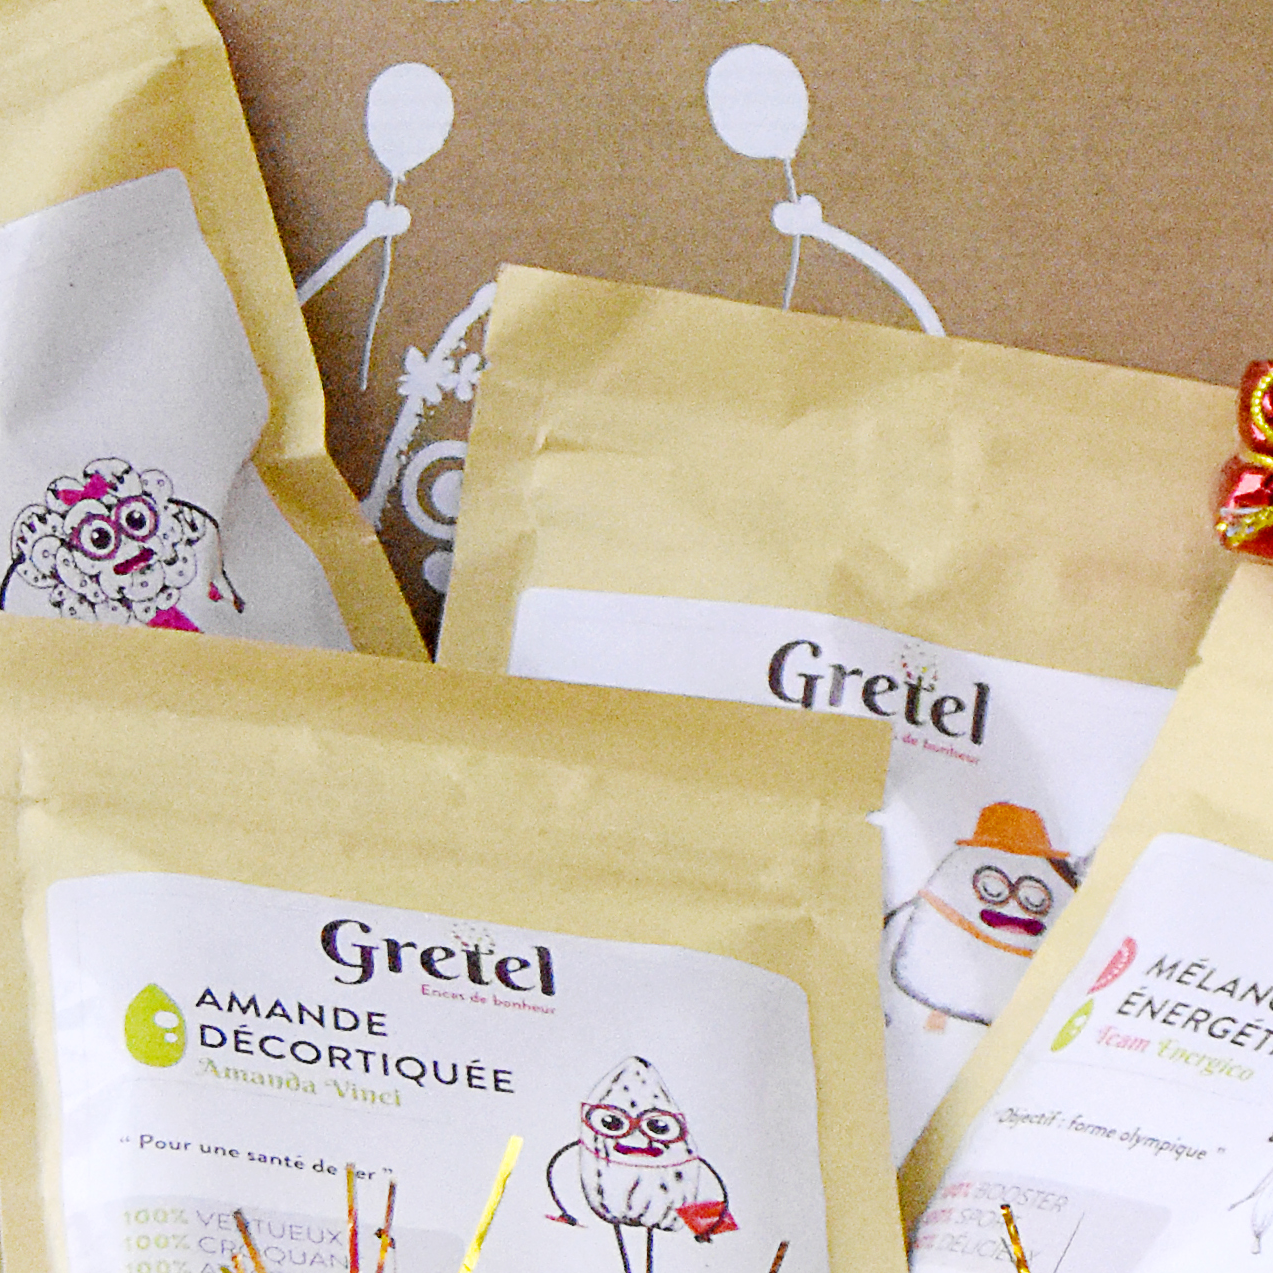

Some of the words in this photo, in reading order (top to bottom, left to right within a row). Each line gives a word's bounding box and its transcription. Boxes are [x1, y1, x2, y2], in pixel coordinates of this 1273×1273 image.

[768, 639, 991, 746] Gretel
[320, 918, 557, 997] Gretel
[195, 987, 389, 1038] AMANDE
[421, 983, 467, 1004] Encas
[469, 992, 489, 1005] de
[492, 995, 557, 1016] bonheur
[200, 1023, 516, 1095] DÉCORTIQUÉE
[138, 1133, 192, 1151] Pour
[200, 1143, 240, 1159] une
[247, 1150, 305, 1171] santé
[312, 1158, 338, 1176] de
[1066, 1113, 1117, 1139] forme
[1118, 1126, 1207, 1161] olympique
[973, 1181, 1070, 1213] BOOSTER
